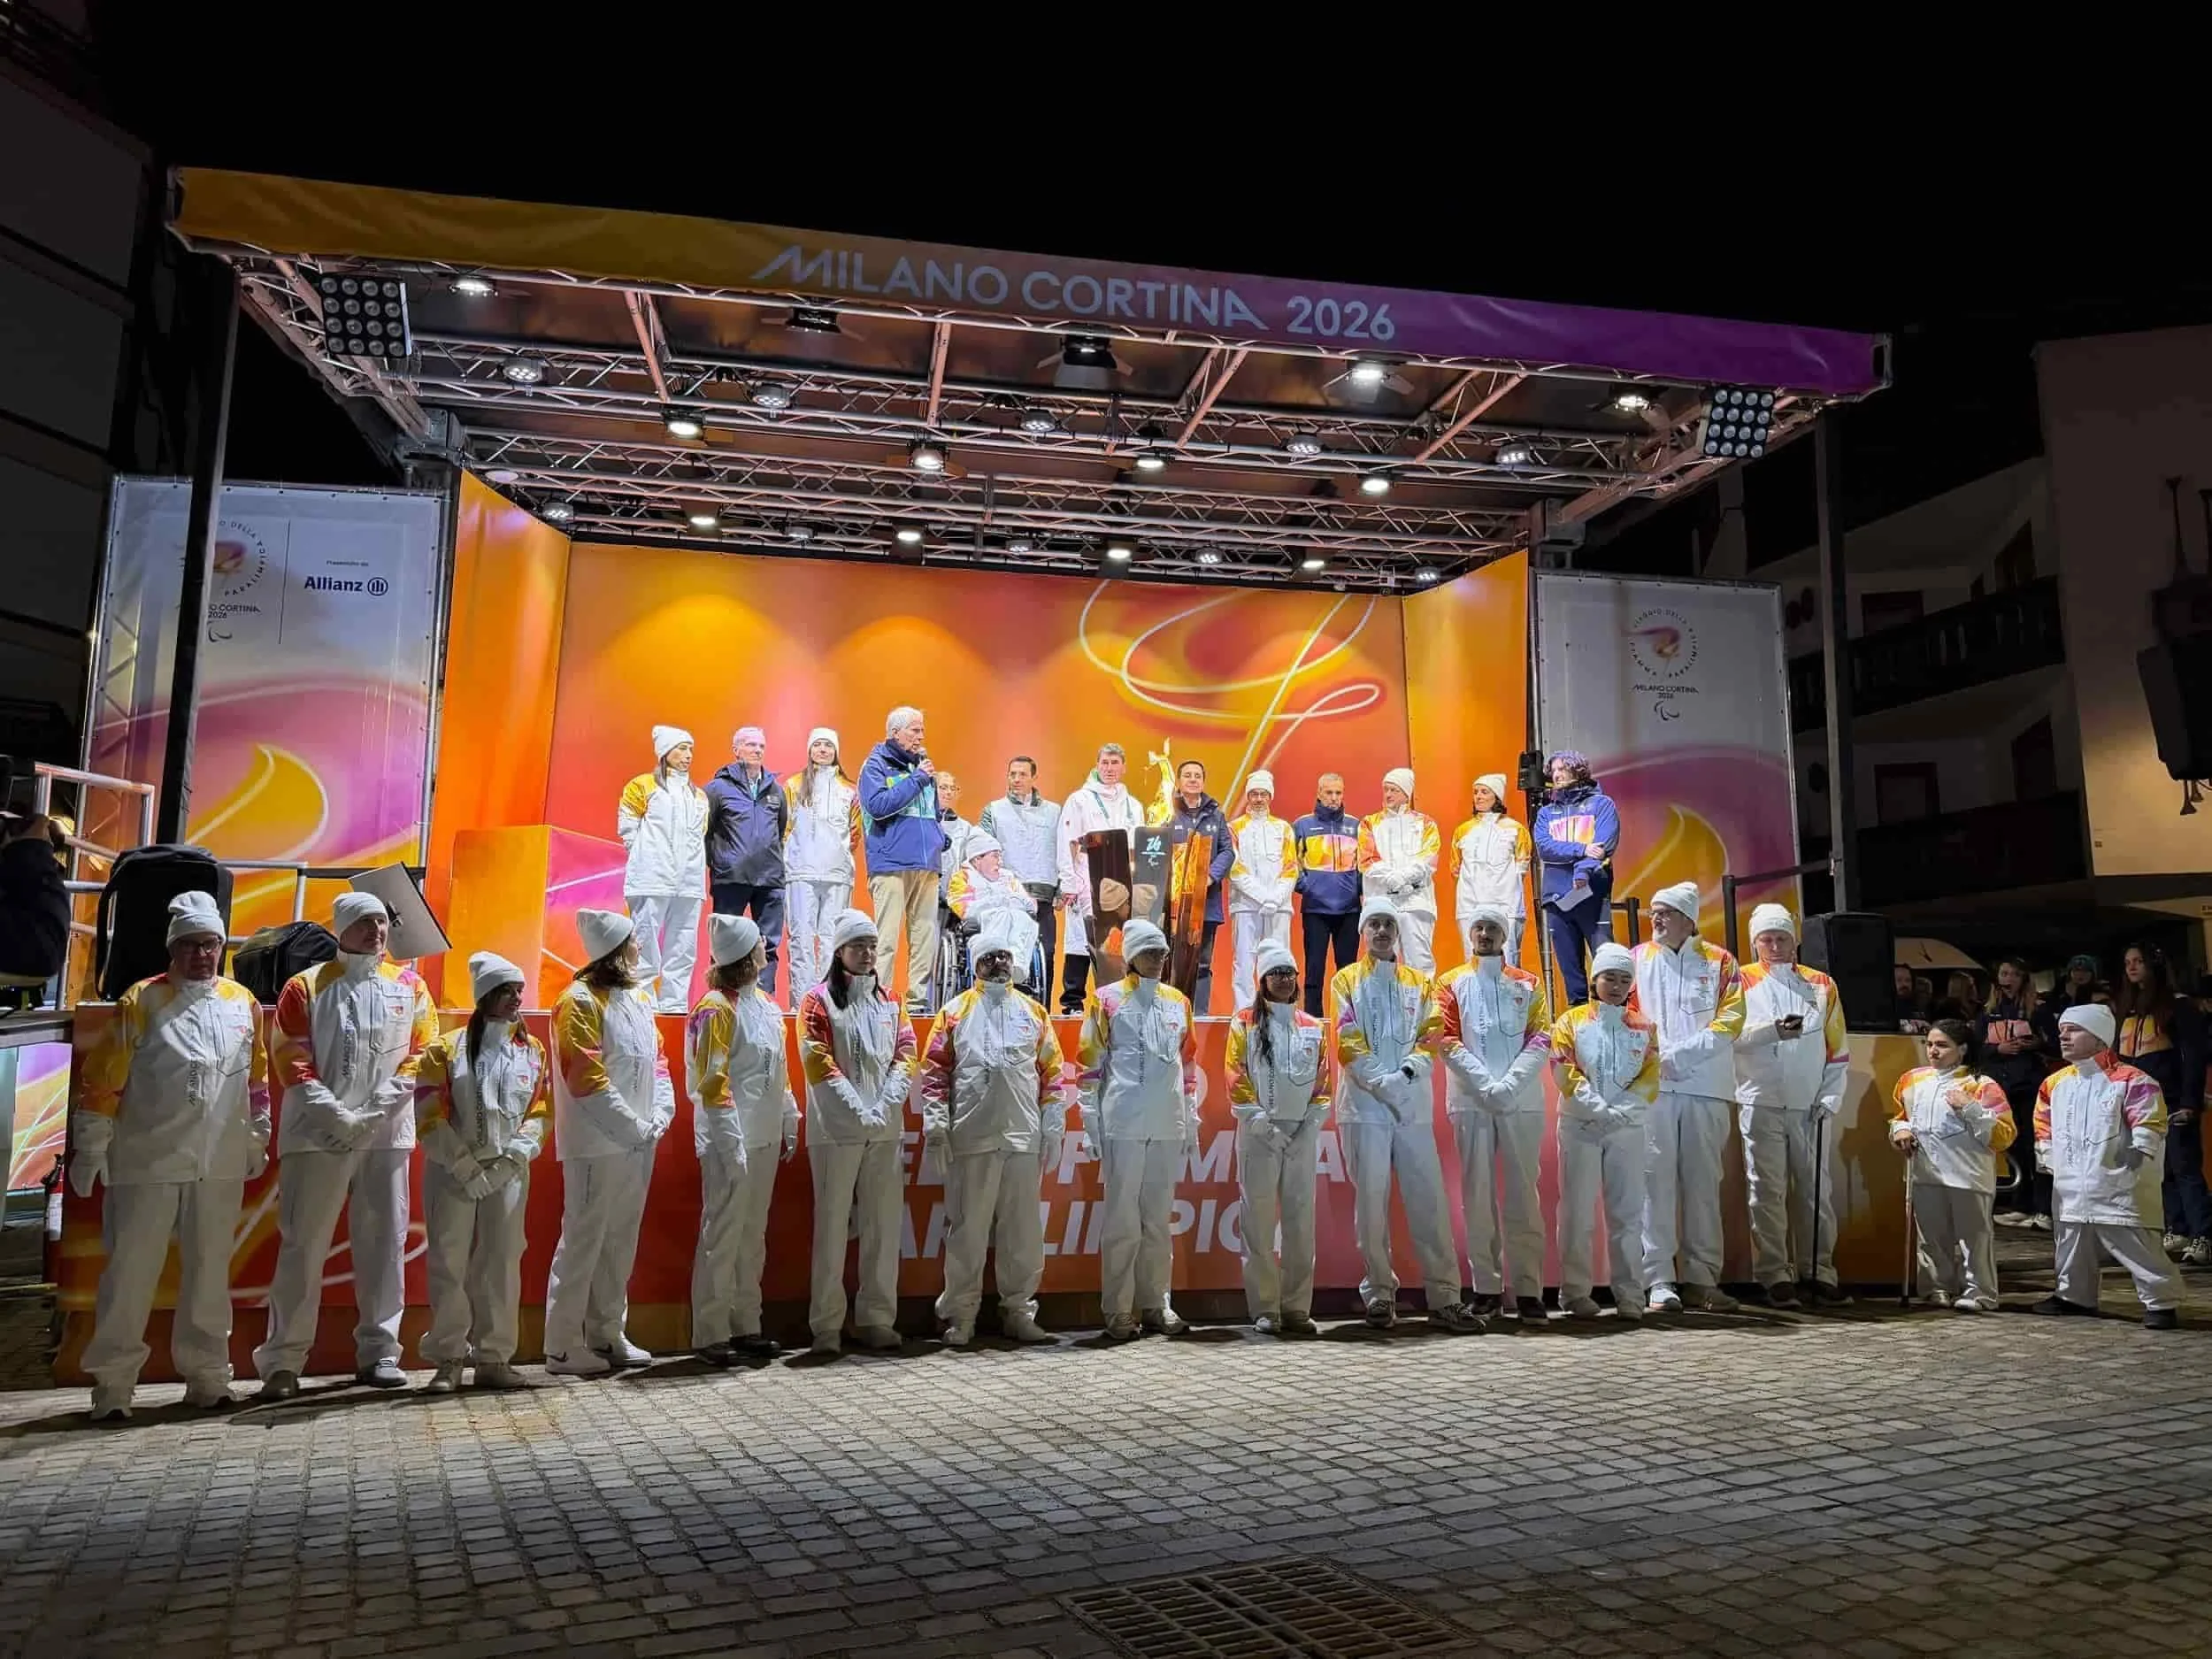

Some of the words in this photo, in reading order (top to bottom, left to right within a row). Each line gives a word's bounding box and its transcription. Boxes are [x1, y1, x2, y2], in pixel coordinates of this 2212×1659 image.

[749, 245, 1008, 304] MILANO
[1022, 271, 1269, 330] CORTINA
[1286, 296, 1395, 342] 2026
[303, 575, 363, 592] Allianz
